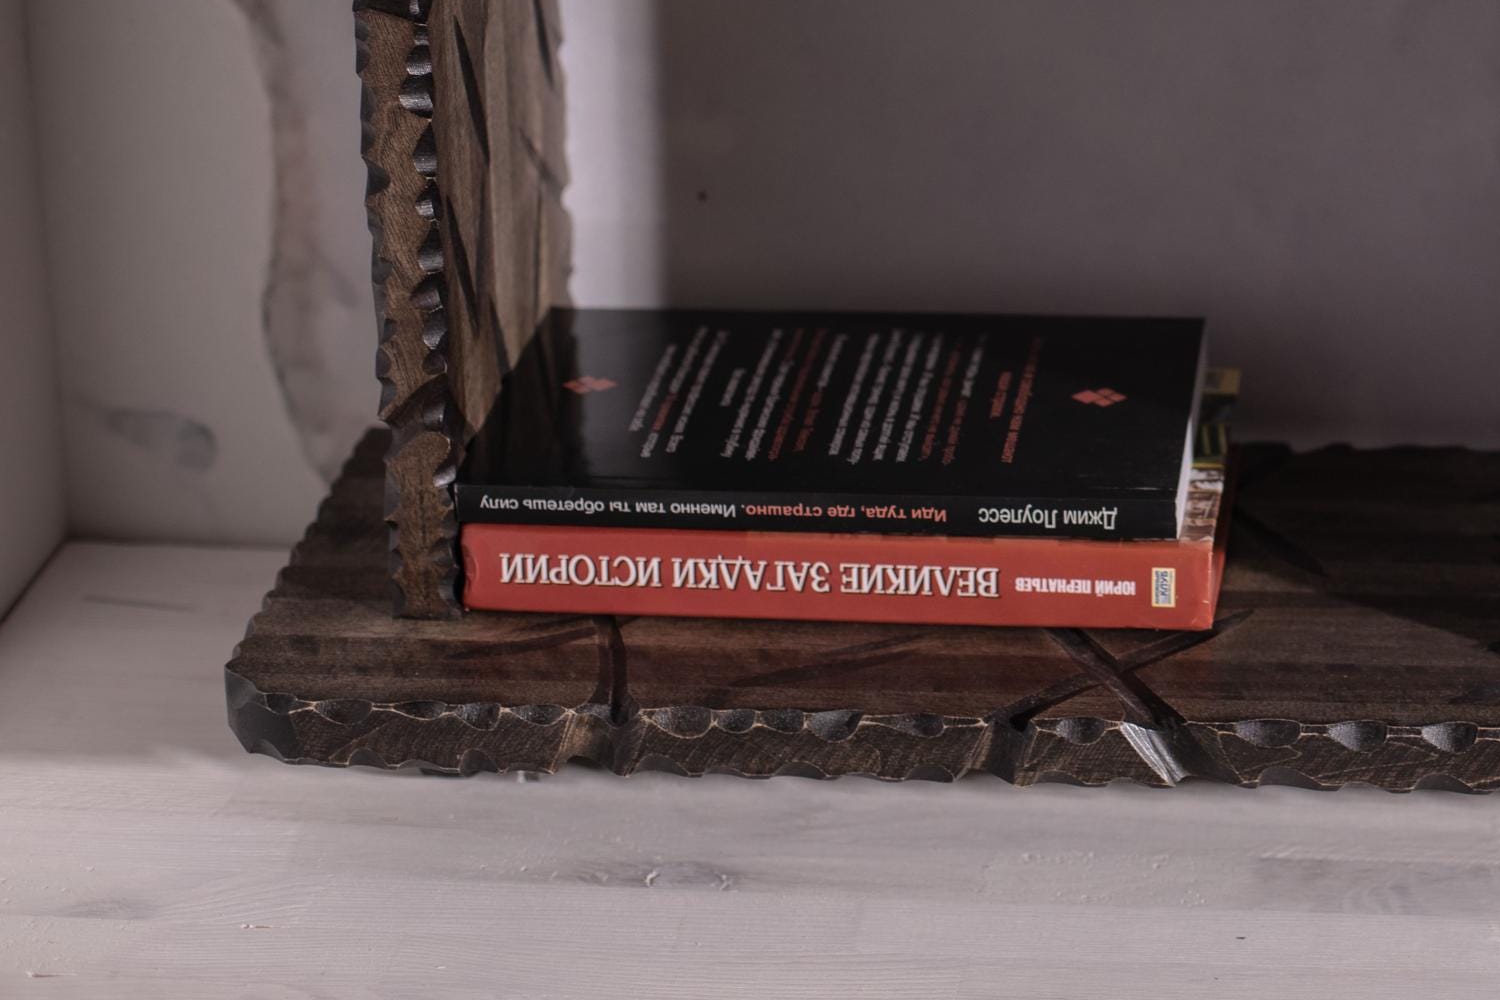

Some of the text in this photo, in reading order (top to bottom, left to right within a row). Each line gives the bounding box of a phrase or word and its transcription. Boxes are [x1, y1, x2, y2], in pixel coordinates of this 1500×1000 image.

[480, 494, 947, 522] Иди туда, где страшно. Именно там ты обретешь силу
[978, 504, 1118, 530] Джим Лоулесс
[499, 553, 1000, 598] ВЕЛИКИЕ ЗАГАДКИ ИСТОРИИ
[1015, 576, 1092, 594] ПЕРНАТЬЕВ
[1096, 580, 1136, 596] ЮРИЙ
